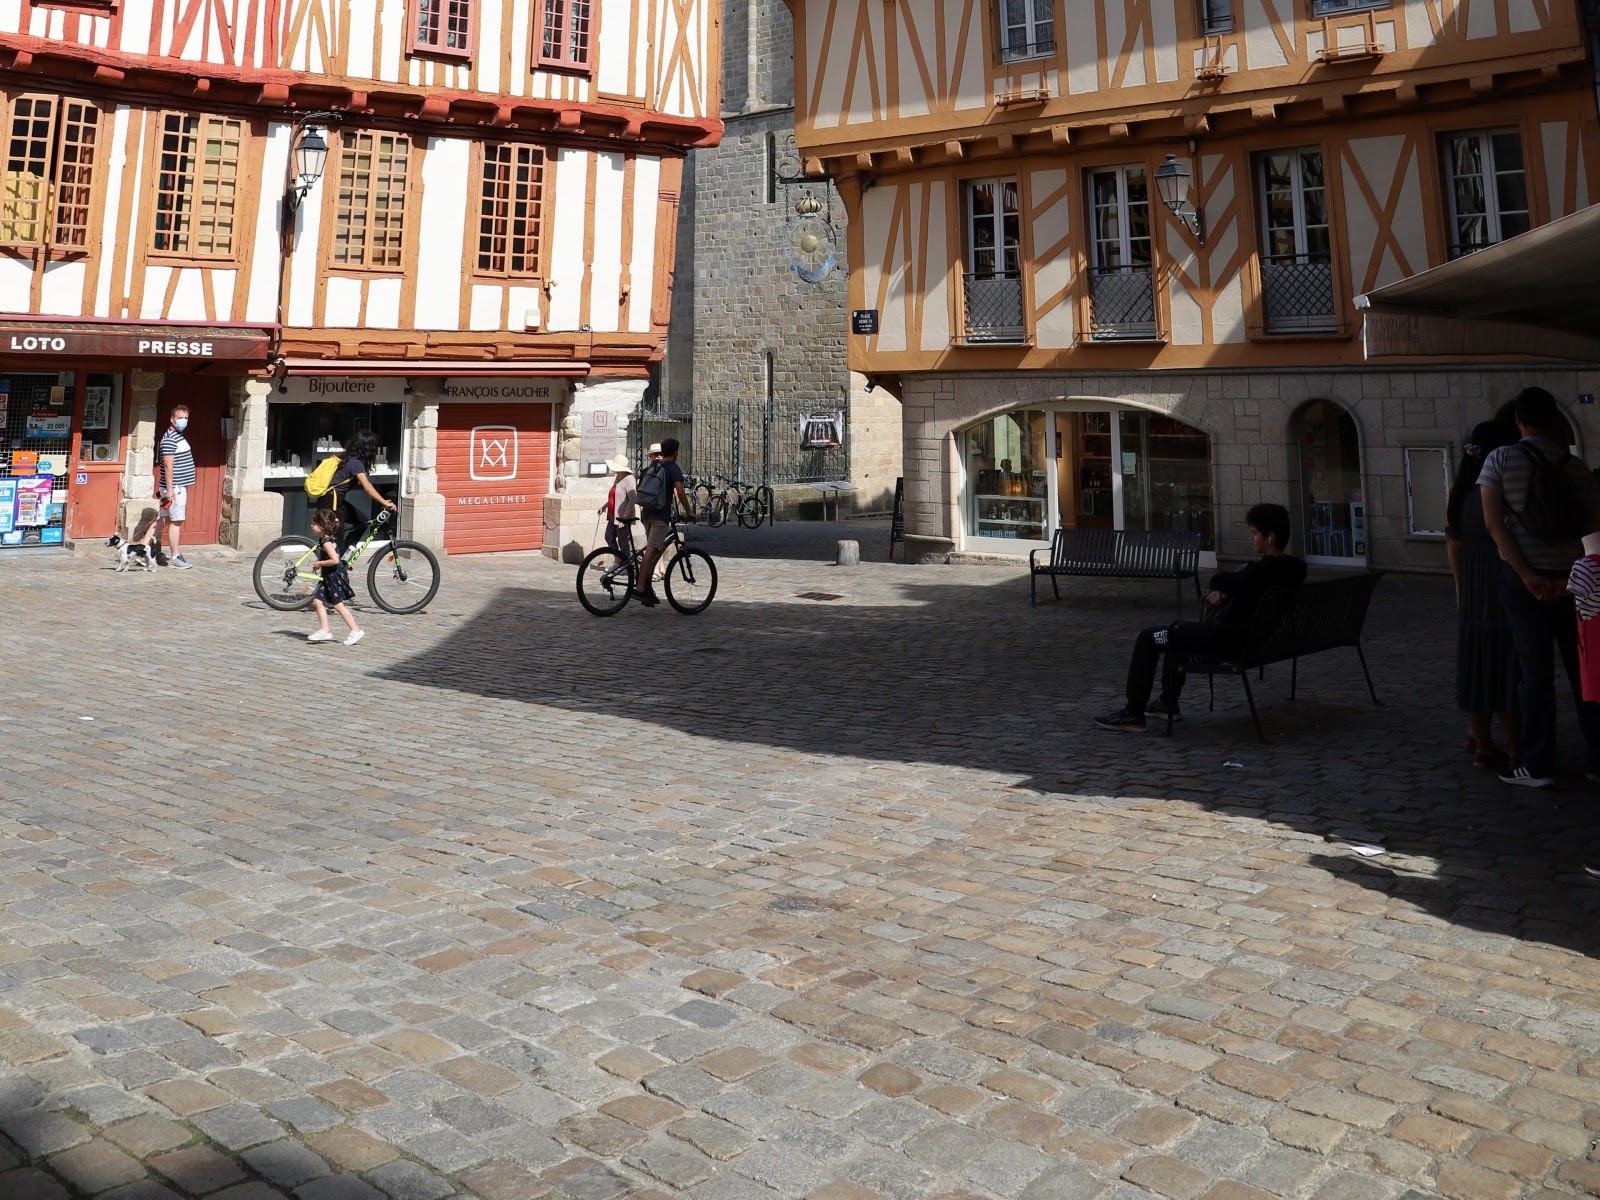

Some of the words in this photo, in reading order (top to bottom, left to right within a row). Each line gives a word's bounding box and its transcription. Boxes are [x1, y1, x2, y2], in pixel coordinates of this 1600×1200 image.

[11, 336, 66, 351] LOTO
[138, 340, 213, 355] PRESSE
[309, 378, 376, 397] Bijouterie
[447, 386, 499, 399] FRANÇOIS
[501, 386, 550, 398] GAUCHER
[458, 495, 526, 505] MEGALITHES
[347, 528, 378, 567] SCRAPPER
